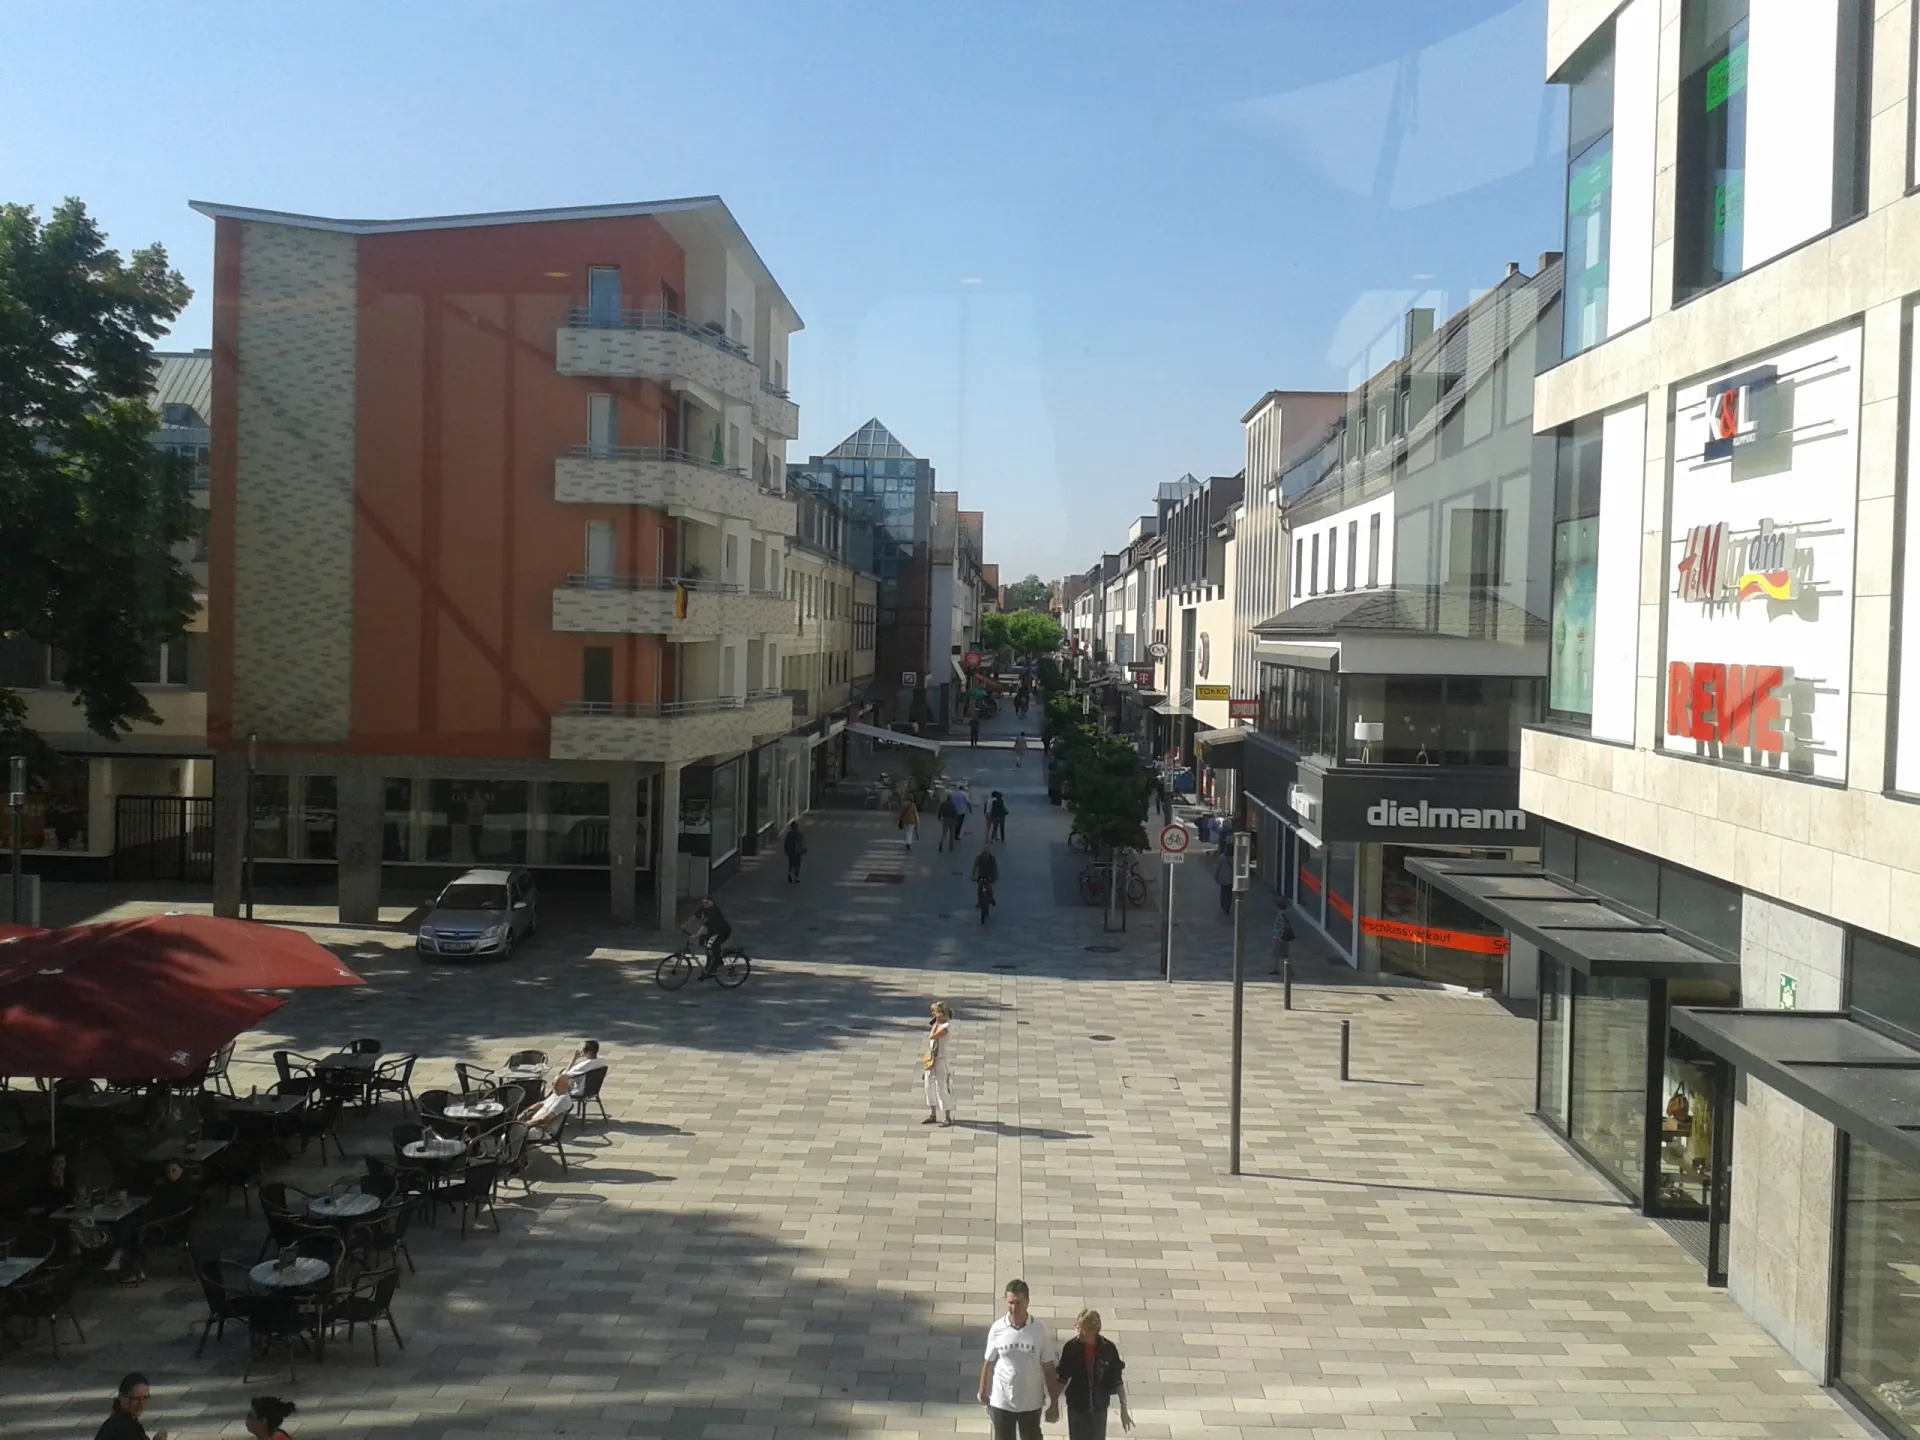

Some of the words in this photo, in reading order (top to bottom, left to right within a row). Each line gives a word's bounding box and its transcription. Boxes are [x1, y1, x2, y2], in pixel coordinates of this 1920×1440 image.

[1705, 386, 1757, 443] K&L
[1749, 518, 1786, 571] dm
[1668, 661, 1783, 753] REWE
[1366, 798, 1527, 830] dielmann
